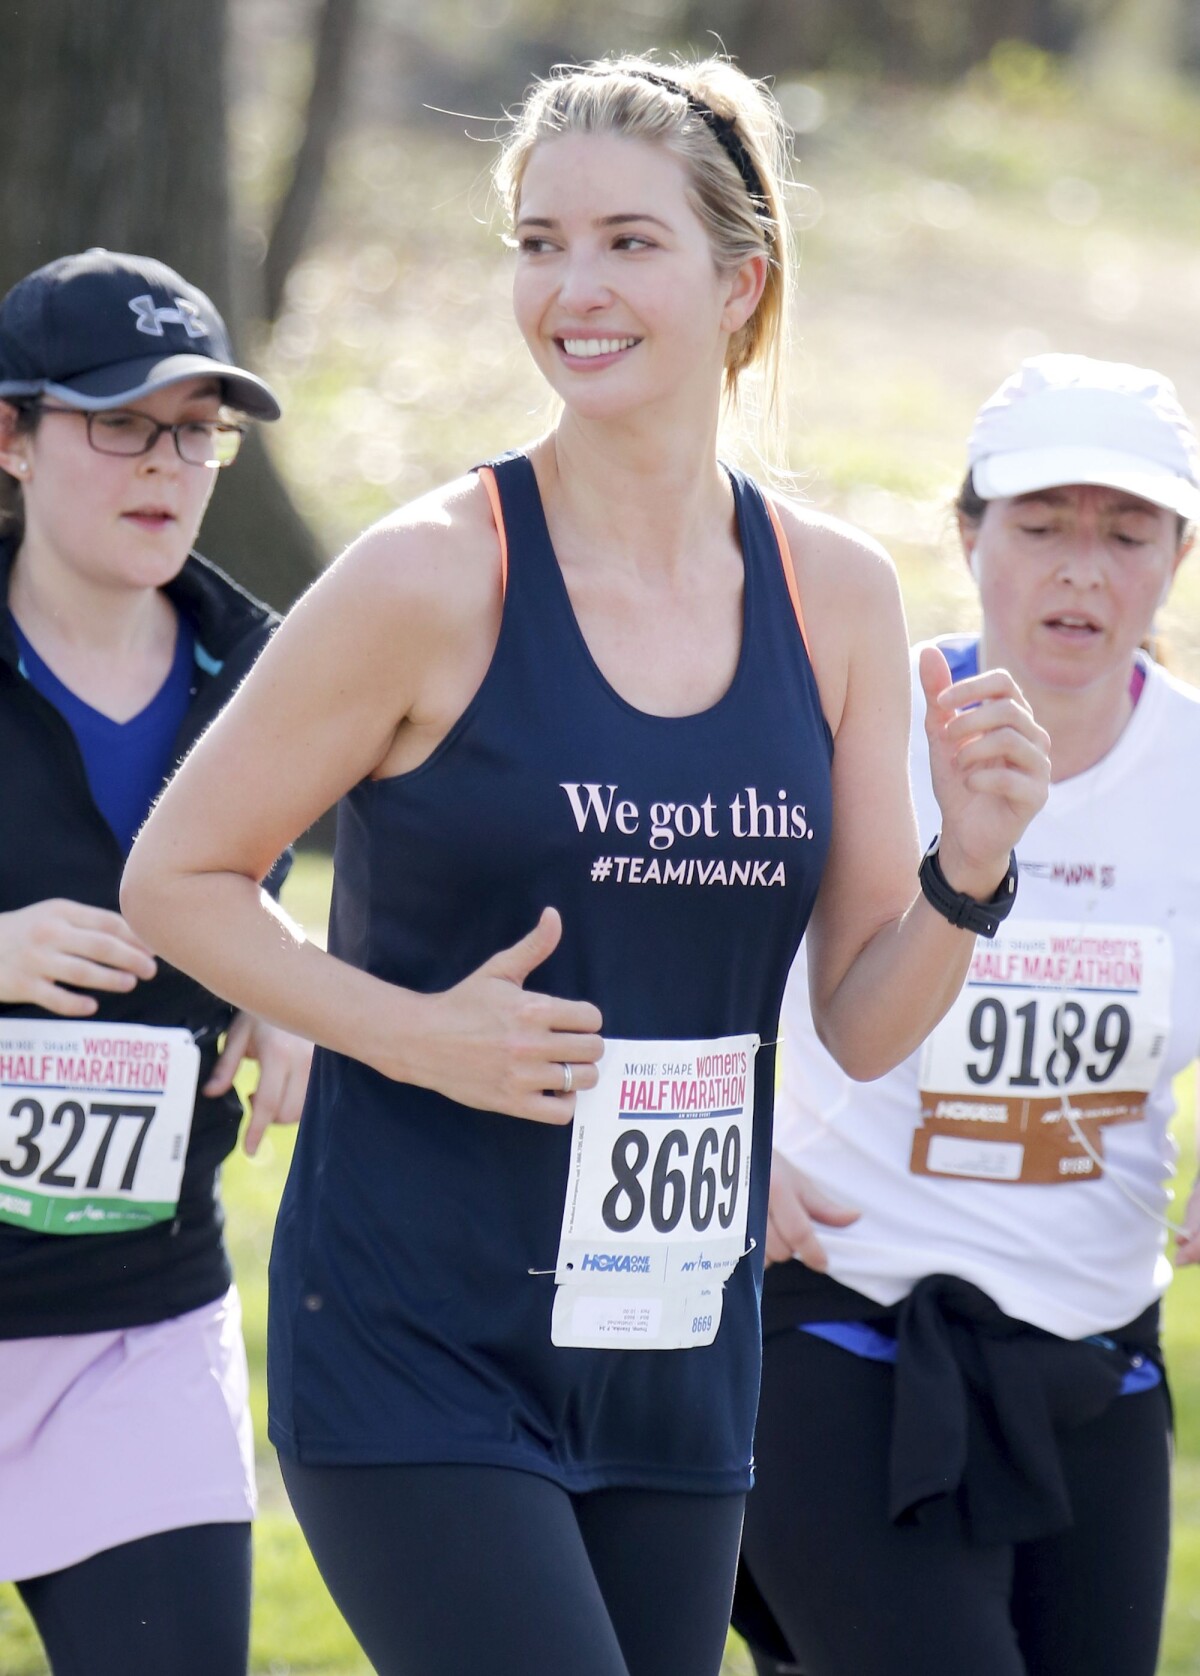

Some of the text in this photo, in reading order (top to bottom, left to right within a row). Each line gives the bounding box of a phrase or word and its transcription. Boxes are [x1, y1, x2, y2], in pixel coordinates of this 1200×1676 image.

[559, 783, 814, 850] We got this.
[591, 856, 786, 887] #TEAMIVANKA
[966, 998, 1131, 1086] 9189
[0, 1056, 168, 1087] HALF MARATHON
[623, 1051, 747, 1079] MORE SHAPE women's
[619, 1075, 746, 1111] HALF MARATHON
[0, 1098, 157, 1191] 3277
[601, 1124, 741, 1234] 8669
[581, 1253, 630, 1272] HOKA
[692, 1315, 713, 1333] 8669
